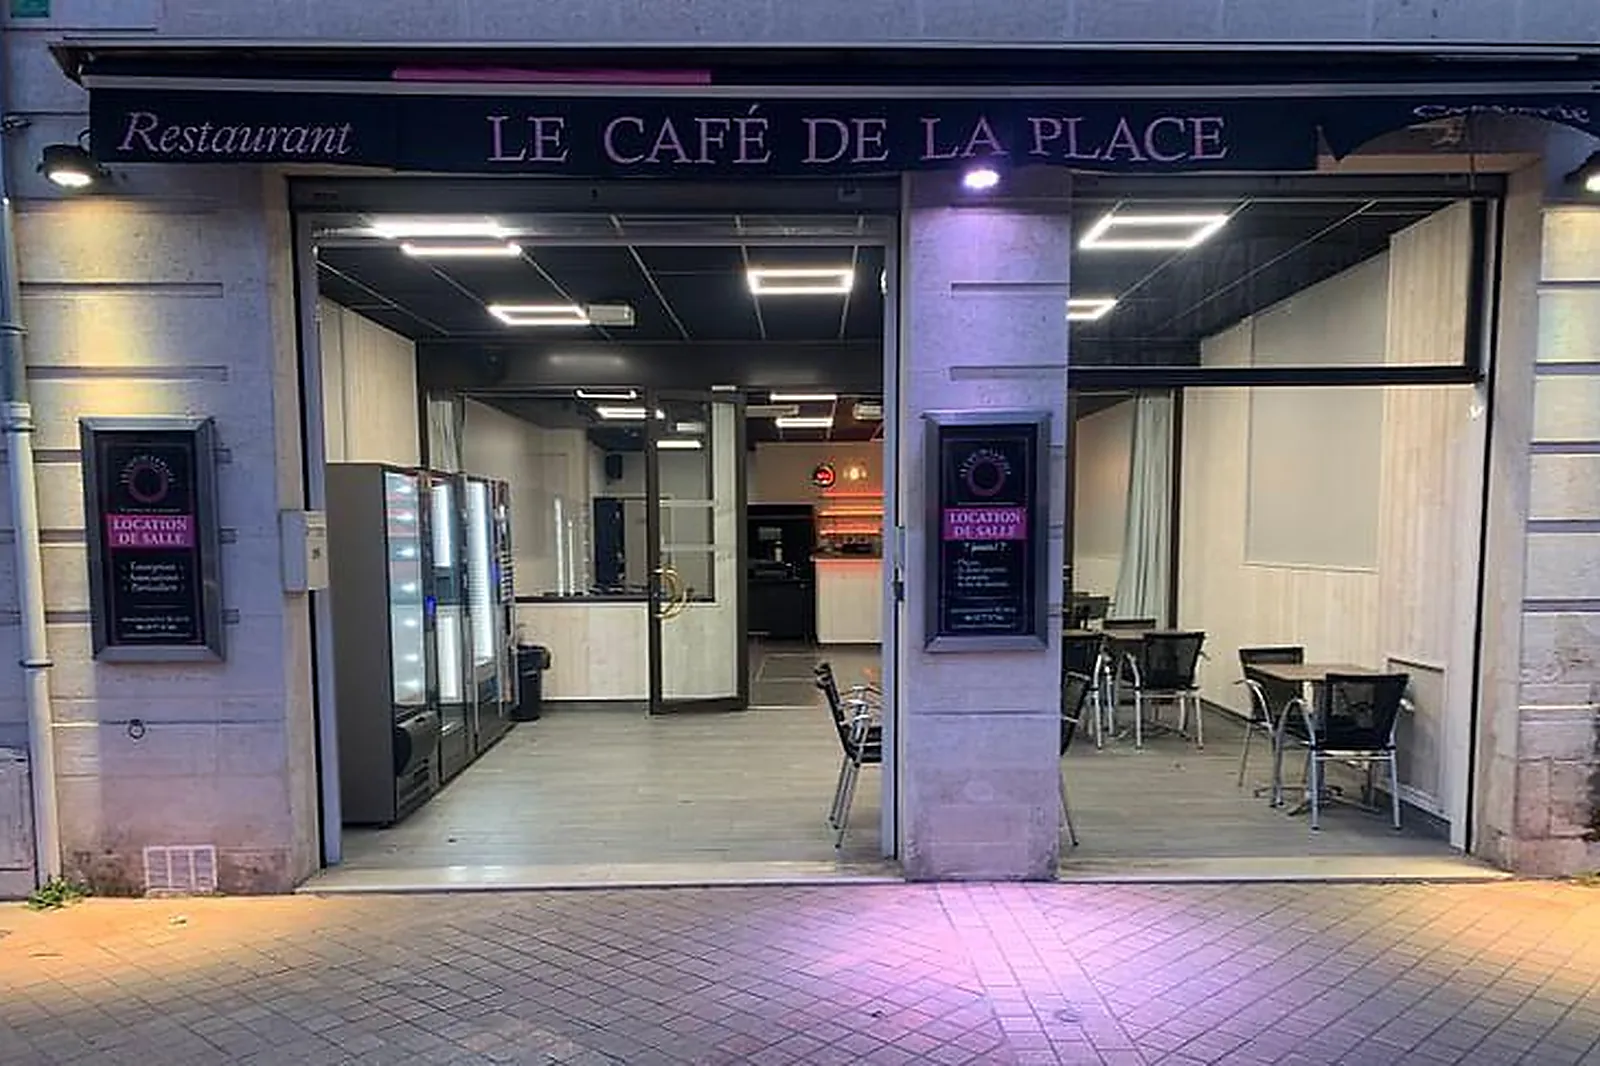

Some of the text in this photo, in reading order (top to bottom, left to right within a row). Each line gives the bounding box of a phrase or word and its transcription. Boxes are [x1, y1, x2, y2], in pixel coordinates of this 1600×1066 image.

[116, 111, 352, 155] Restaurant
[486, 104, 1229, 164] LE CAFÉ DE LA PLACE
[113, 518, 188, 531] LOCATION
[950, 511, 1021, 524] LOCATION
